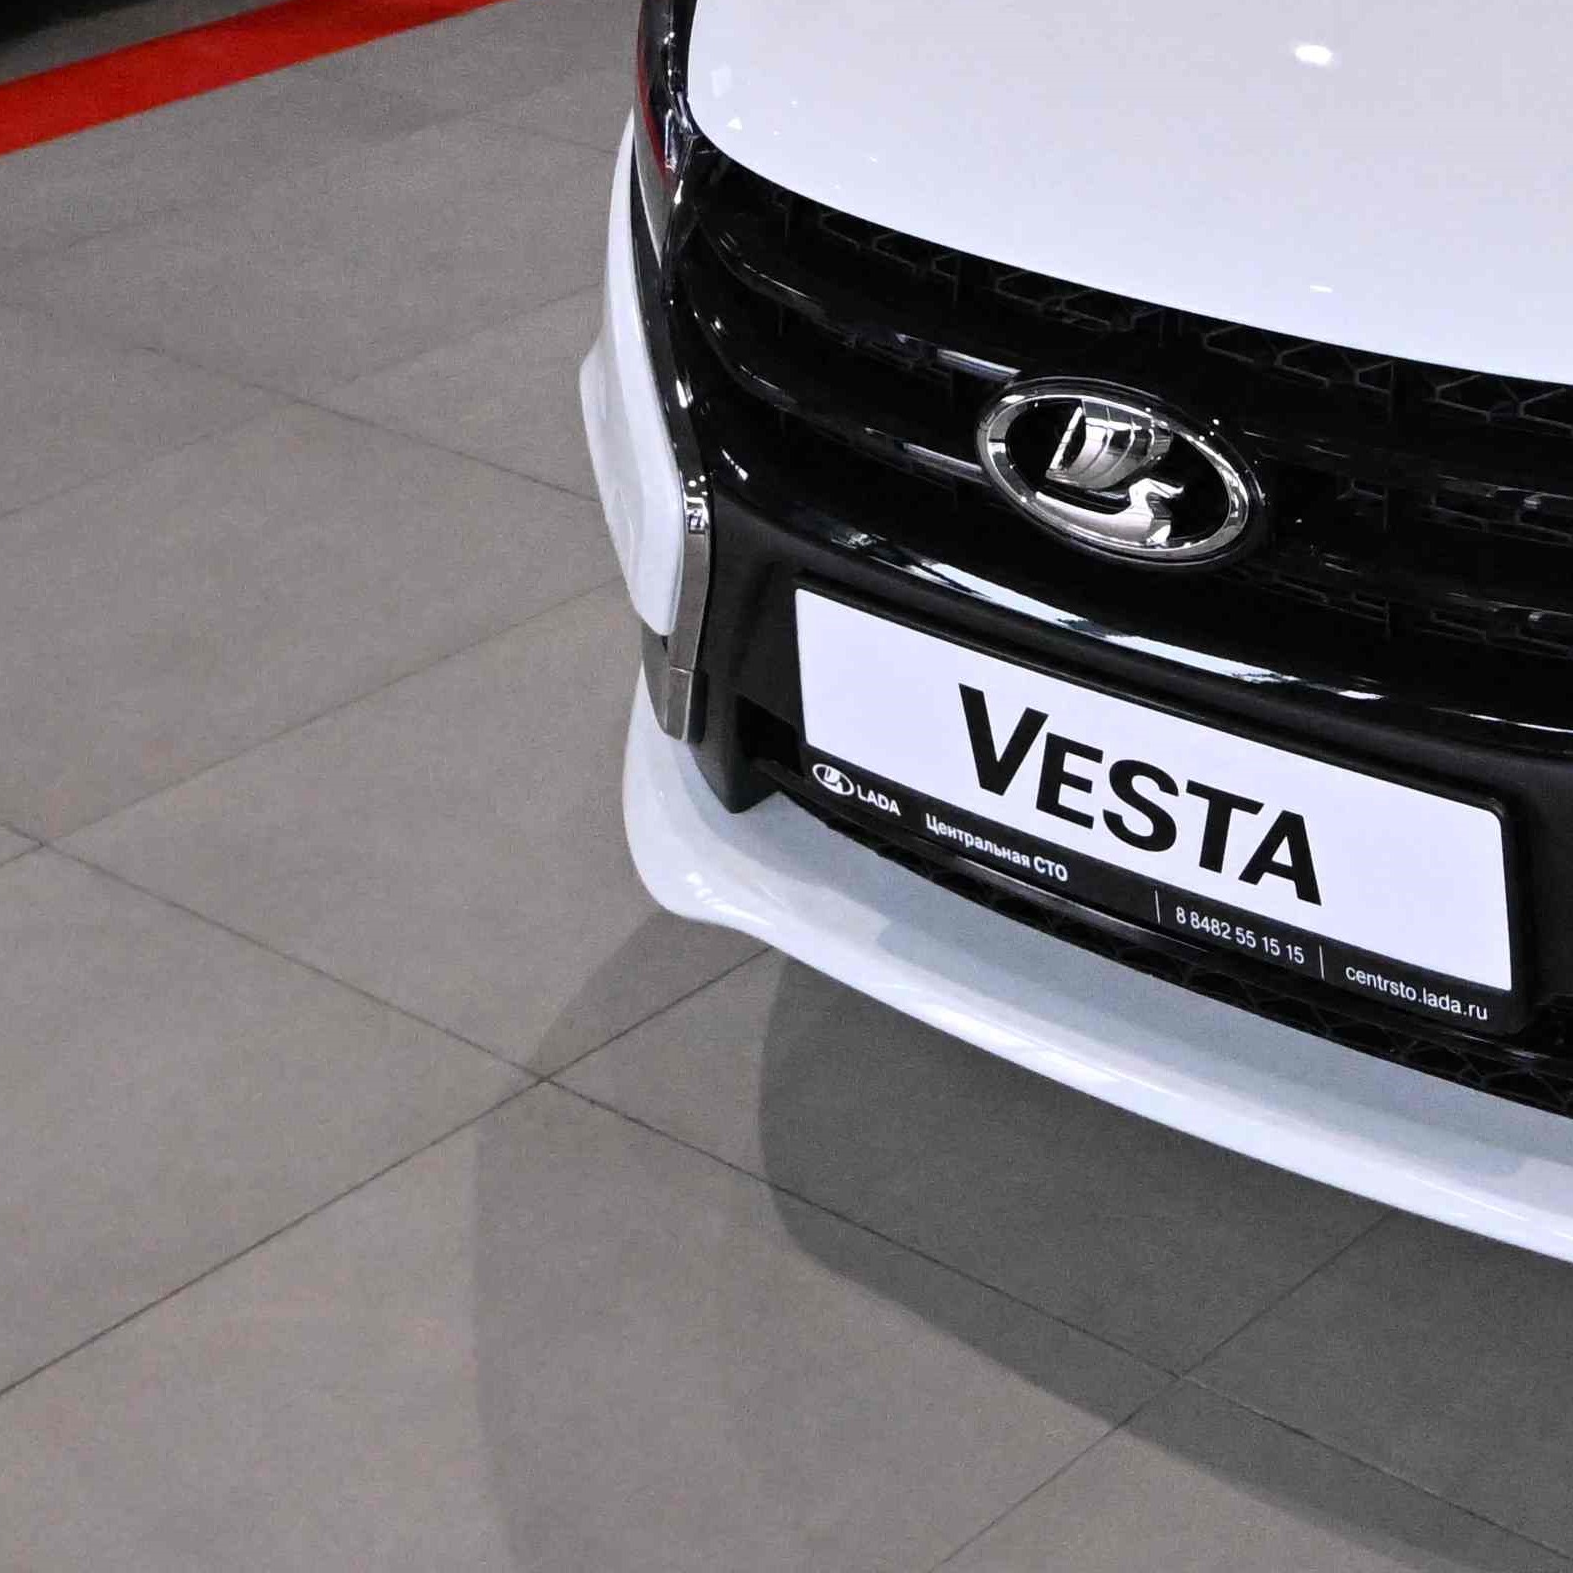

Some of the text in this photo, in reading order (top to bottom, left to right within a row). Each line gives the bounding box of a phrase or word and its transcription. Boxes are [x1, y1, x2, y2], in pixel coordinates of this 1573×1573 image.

[857, 784, 902, 816] LADA
[958, 682, 1322, 907] VESTA
[926, 812, 1069, 882] Центральная СТО
[1176, 906, 1305, 965] 8 8482 55 15 15
[1345, 964, 1489, 1022] centrsto.lada.ru
